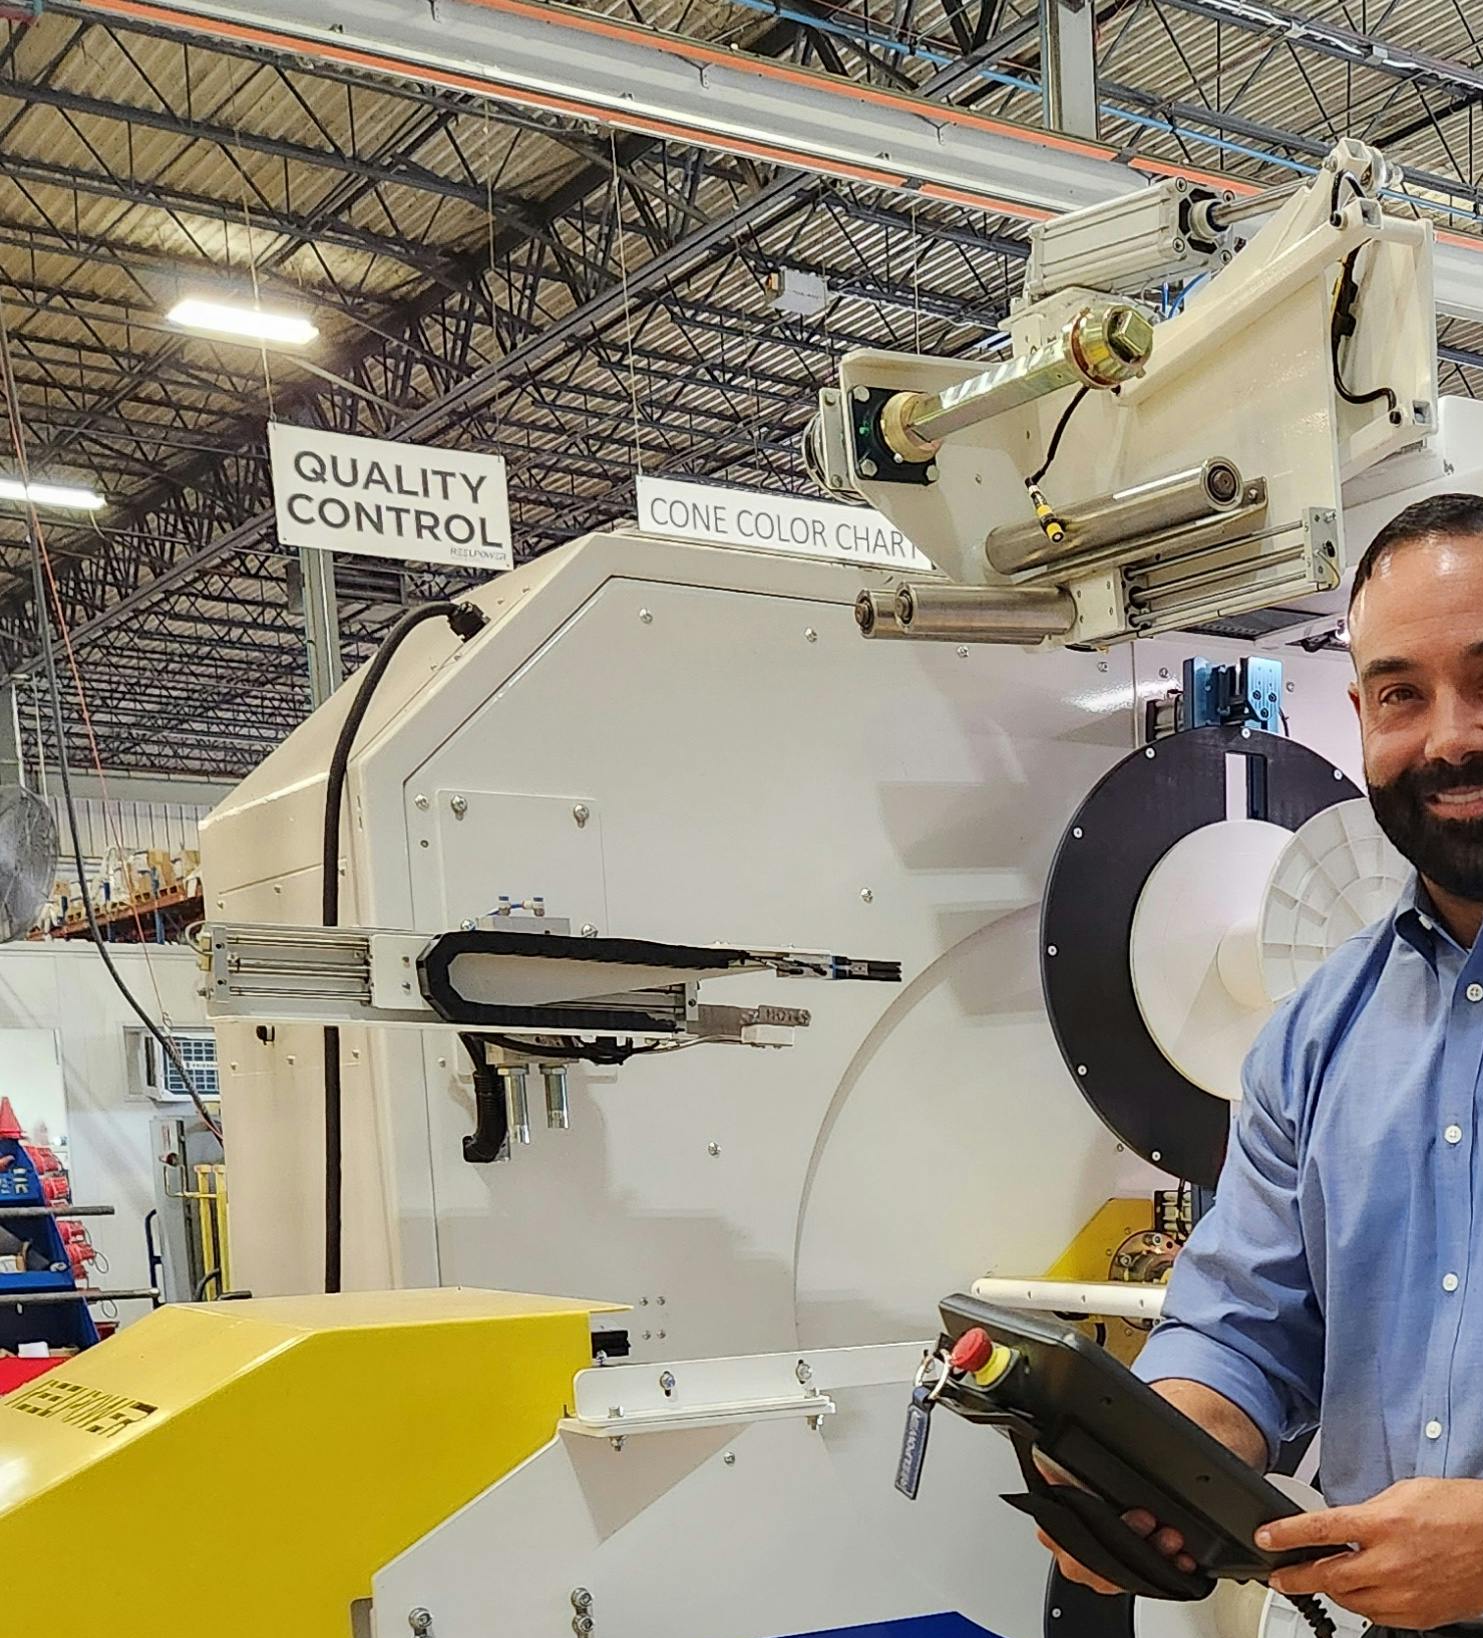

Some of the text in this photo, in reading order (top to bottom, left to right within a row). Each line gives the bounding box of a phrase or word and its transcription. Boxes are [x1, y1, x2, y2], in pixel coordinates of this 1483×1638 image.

[294, 450, 487, 504] QUALITY
[287, 493, 503, 549] CONTROL
[650, 497, 728, 534] CONE
[737, 509, 828, 548] COLOR
[4, 1378, 159, 1438] REELPOWER
